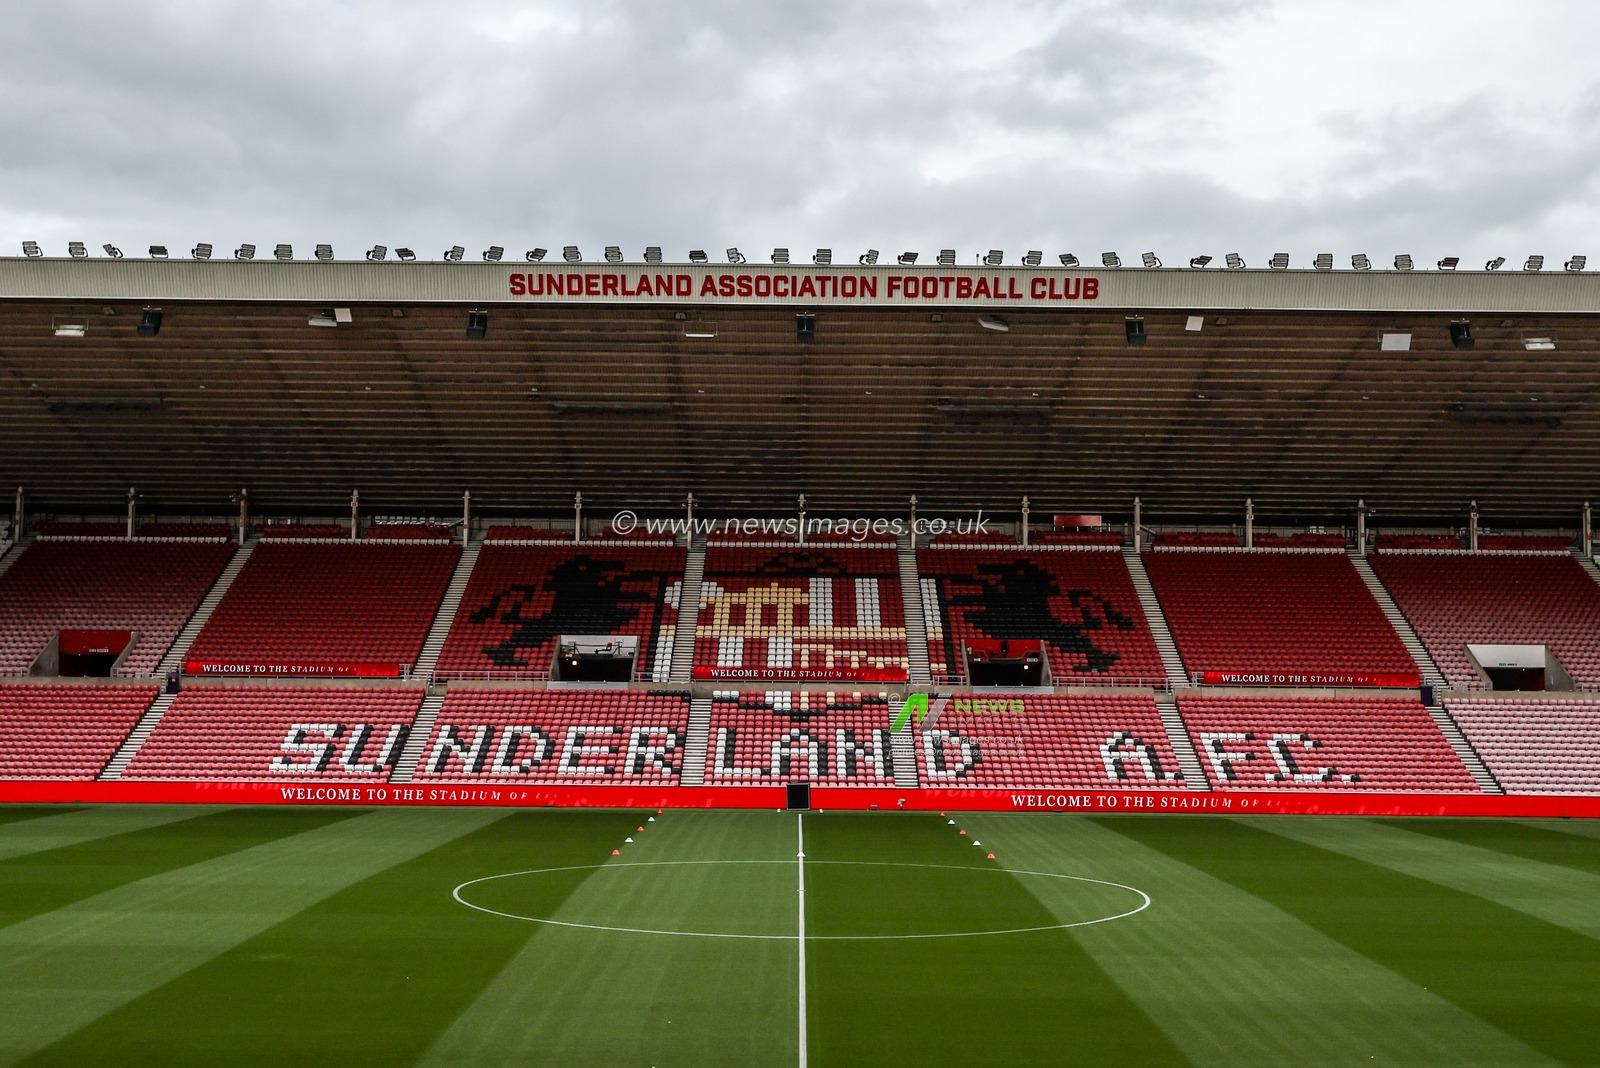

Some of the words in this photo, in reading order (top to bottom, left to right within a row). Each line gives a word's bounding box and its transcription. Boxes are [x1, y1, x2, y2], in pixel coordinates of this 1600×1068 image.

[510, 273, 693, 296] SUNDERLAND
[700, 274, 877, 298] ASSOCIATION
[887, 276, 1023, 299] FOOTBALL
[1030, 277, 1099, 300] CLUB
[202, 664, 251, 673] WELCOME
[253, 665, 266, 674] TO
[268, 665, 288, 674] THE
[290, 665, 334, 674] STADIUM
[710, 668, 760, 678] WELCOME
[761, 669, 774, 678] TO
[777, 669, 797, 678] THE
[798, 669, 842, 678] STADIUM
[1221, 673, 1271, 683] WELCOME
[1272, 674, 1285, 683] TO
[1287, 674, 1308, 683] THE
[1310, 675, 1354, 684] STADIUM
[280, 787, 361, 801] WELCOME
[366, 788, 387, 801] TO
[392, 789, 424, 801] THE
[429, 790, 501, 801] STADIUM
[509, 791, 527, 801] OF
[1010, 794, 1092, 808] WELCOME
[1097, 795, 1118, 808] TO
[1123, 796, 1155, 808] THE
[1160, 796, 1233, 808] STADIUM
[1240, 798, 1259, 809] OF
